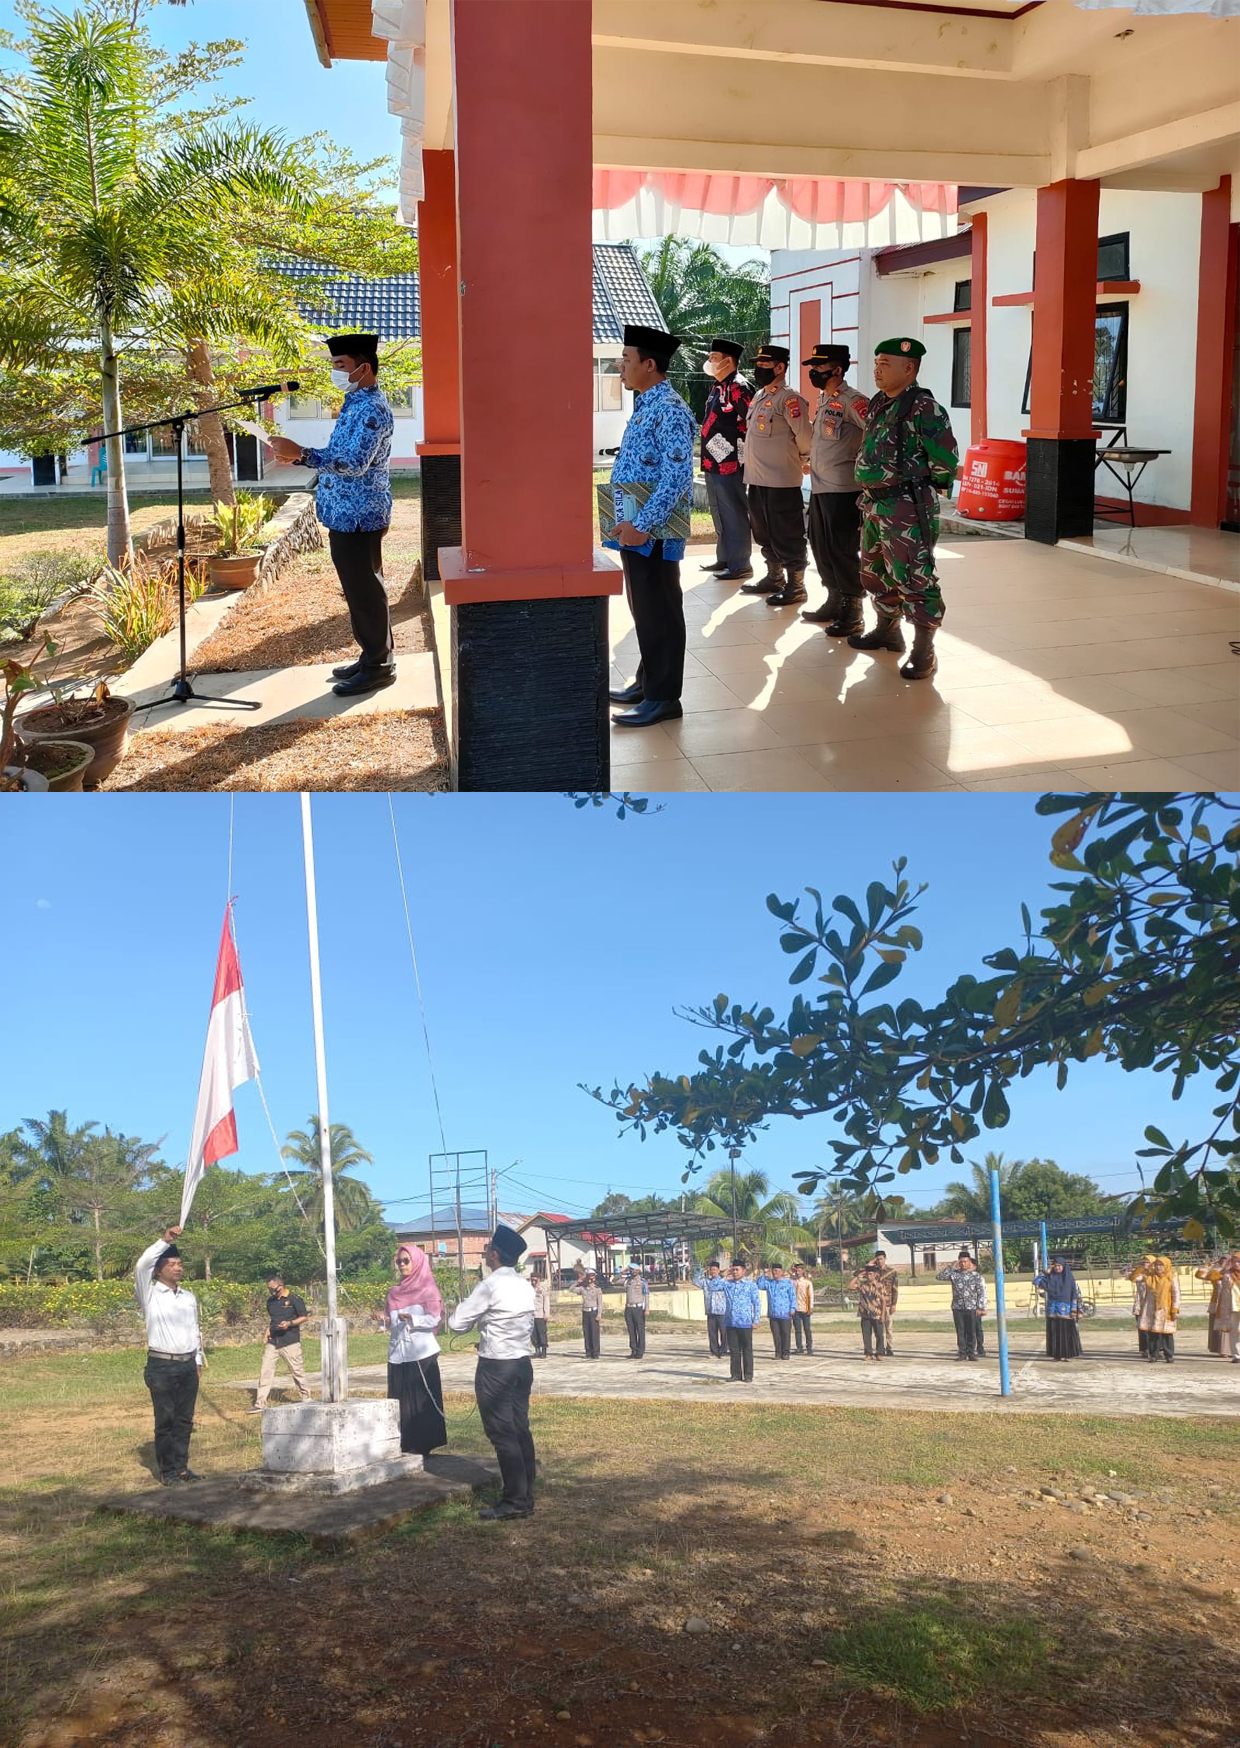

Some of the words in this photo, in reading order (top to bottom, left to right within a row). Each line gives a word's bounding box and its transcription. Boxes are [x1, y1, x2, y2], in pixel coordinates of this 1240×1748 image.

[825, 409, 844, 418] POLRI
[971, 460, 988, 477] SNI
[615, 489, 623, 506] SILA
